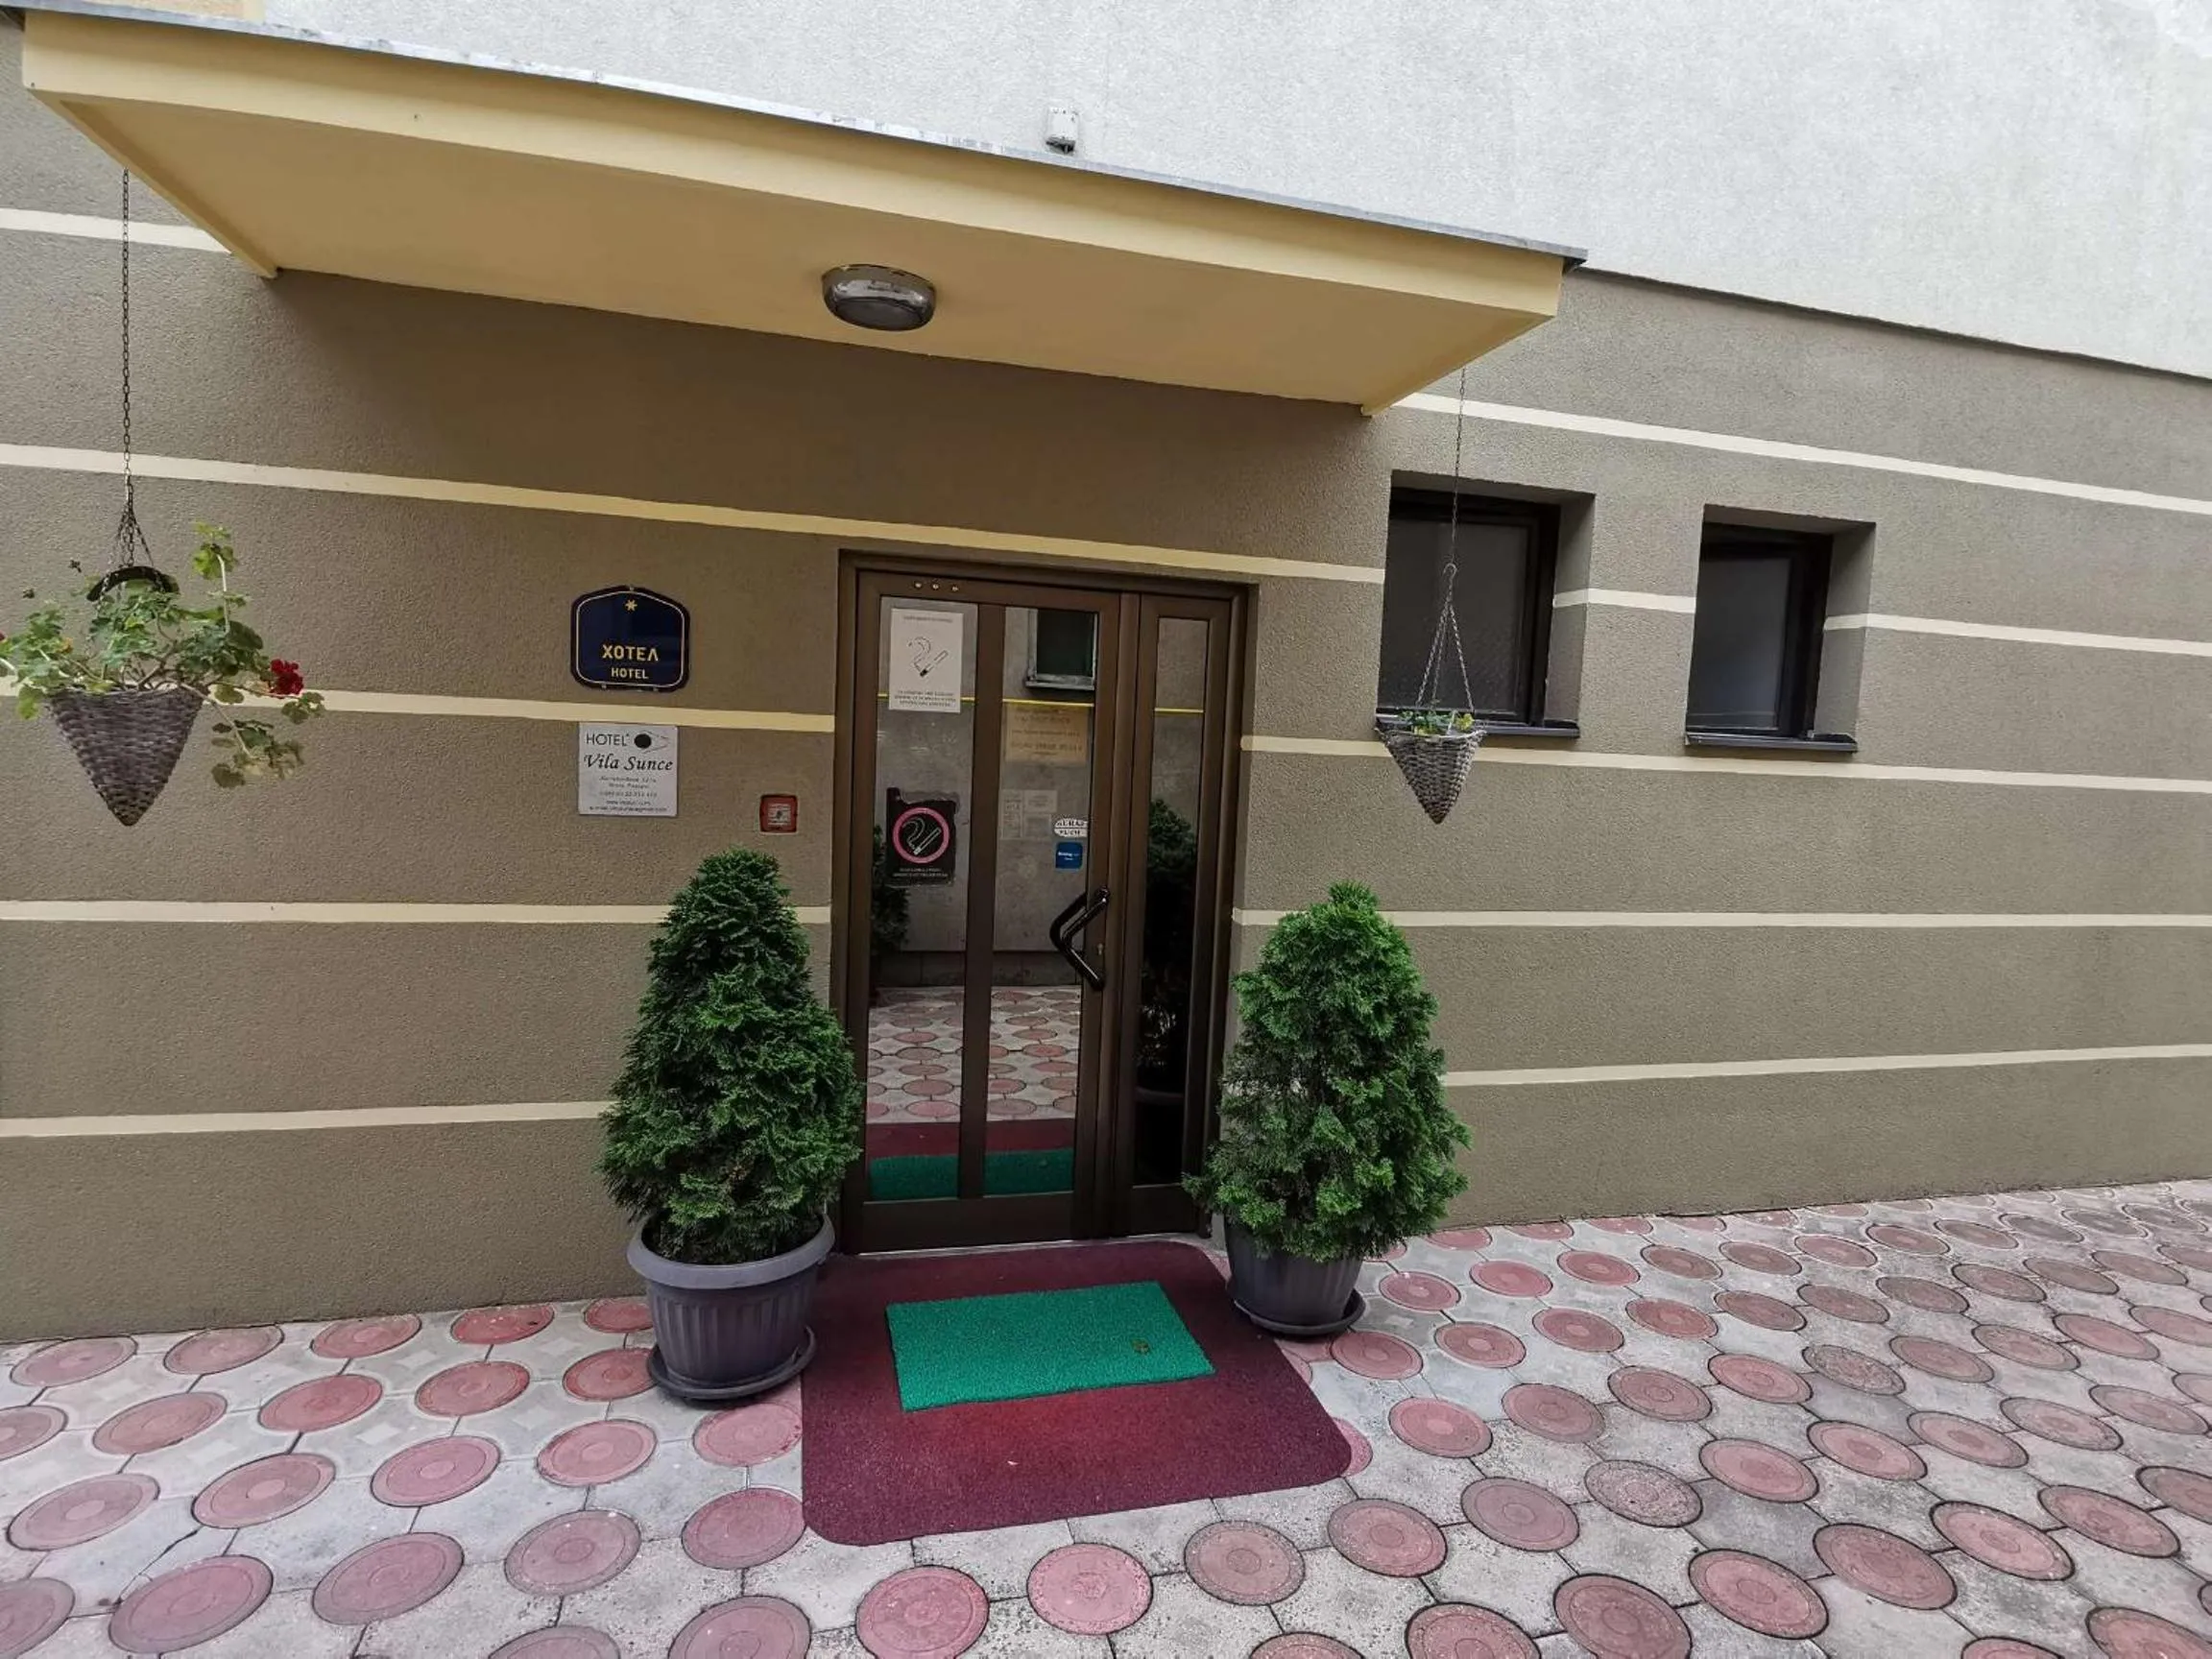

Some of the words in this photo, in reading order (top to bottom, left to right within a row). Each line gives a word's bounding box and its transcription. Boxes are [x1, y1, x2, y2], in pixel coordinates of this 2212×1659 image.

[611, 667, 649, 680] HOTEL
[586, 733, 627, 746] HOTEL
[584, 753, 620, 769] Vila
[623, 756, 674, 771] Sunce
